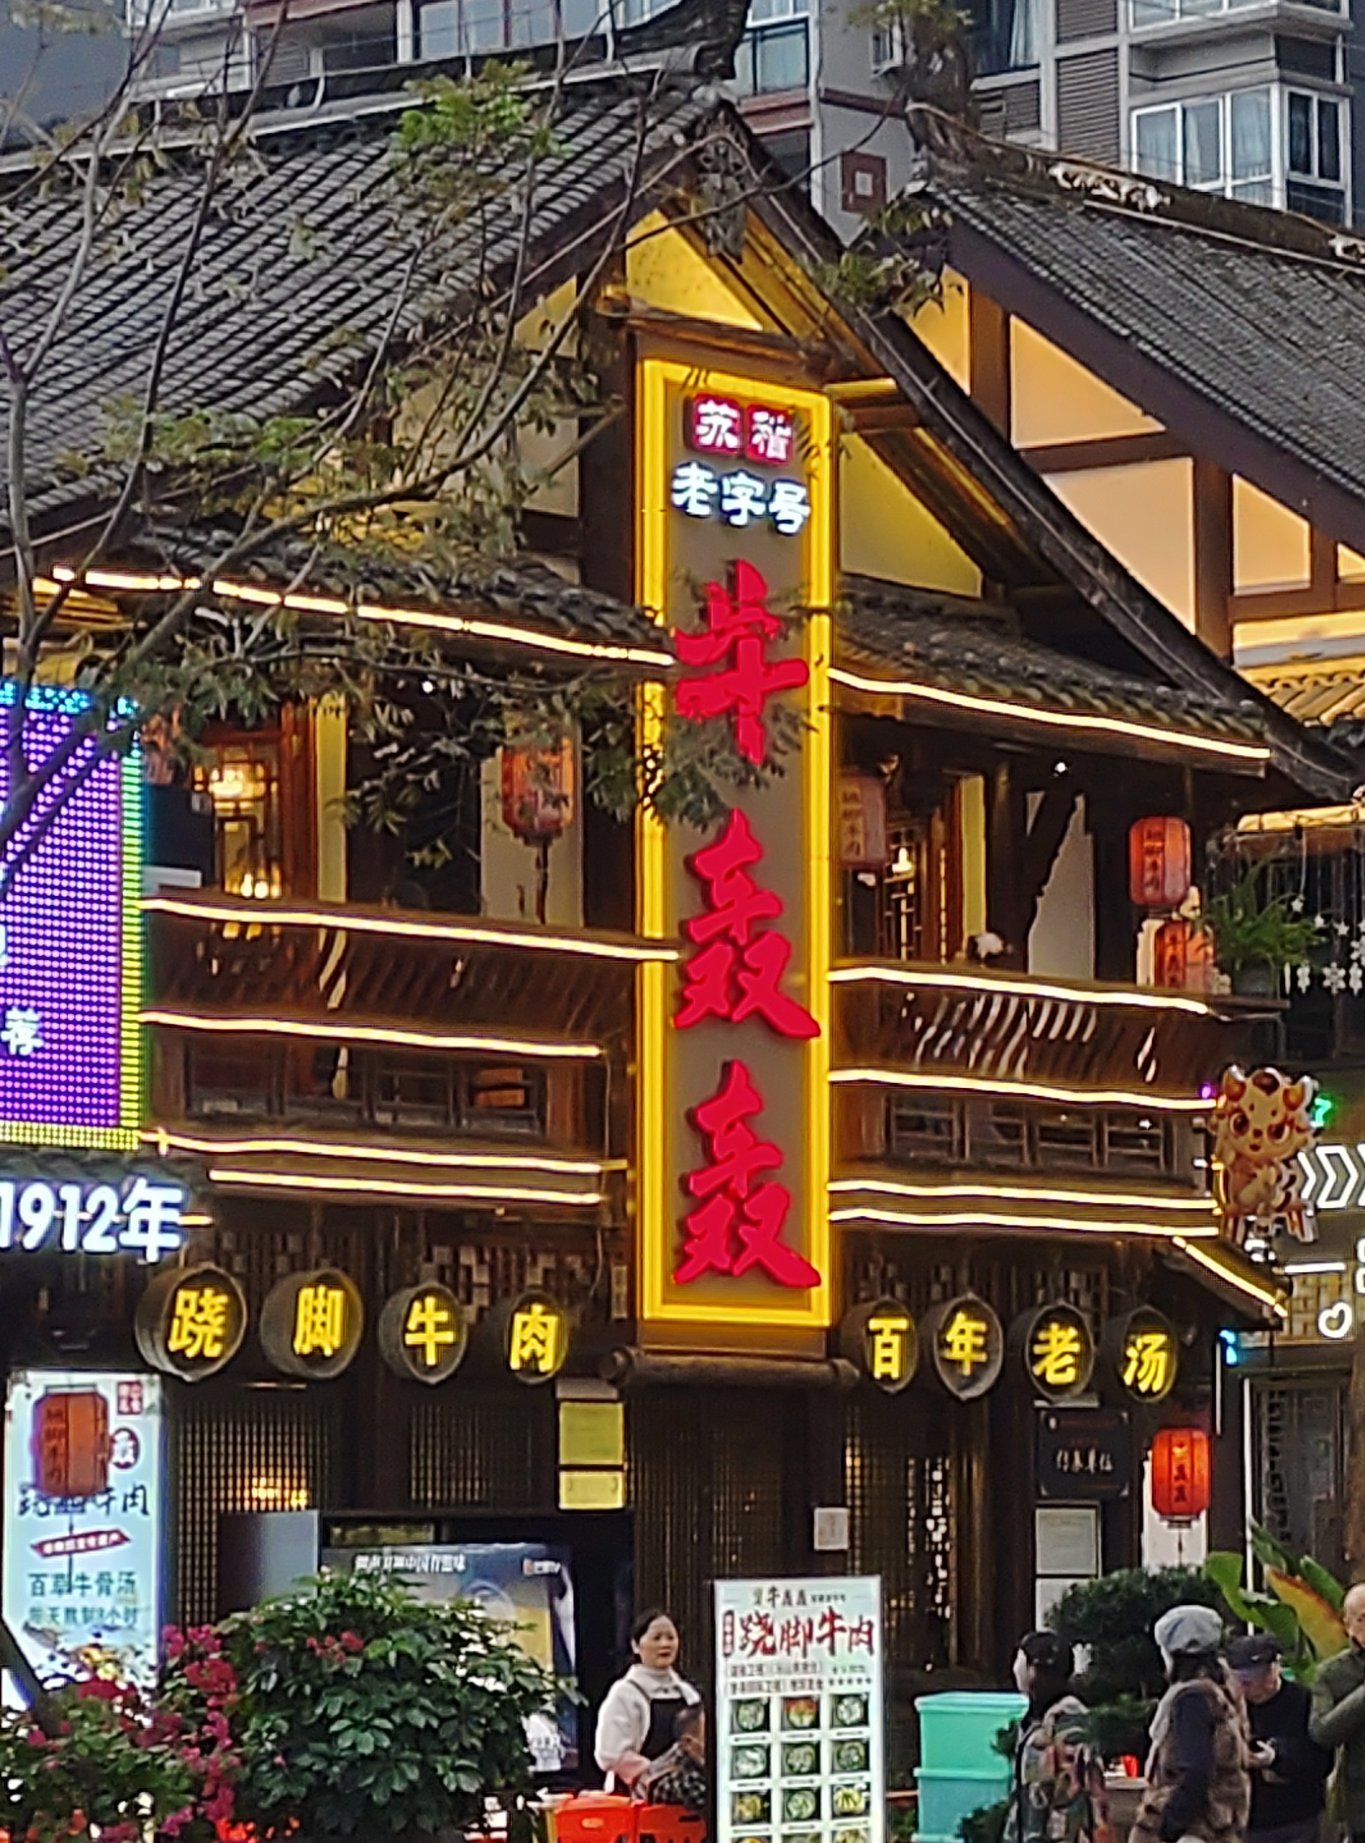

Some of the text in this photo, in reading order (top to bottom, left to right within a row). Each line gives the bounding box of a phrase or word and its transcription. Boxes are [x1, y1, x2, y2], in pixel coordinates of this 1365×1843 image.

[695, 399, 792, 461] 苏稽
[671, 461, 812, 535] 老字号
[673, 558, 822, 1289] 牛轰轰
[0, 1177, 184, 1264] 1912年
[167, 1284, 558, 1373] 跷脚牛肉
[867, 1312, 1169, 1393] 百年老汤
[739, 1606, 875, 1659] 跷脚牛肉
